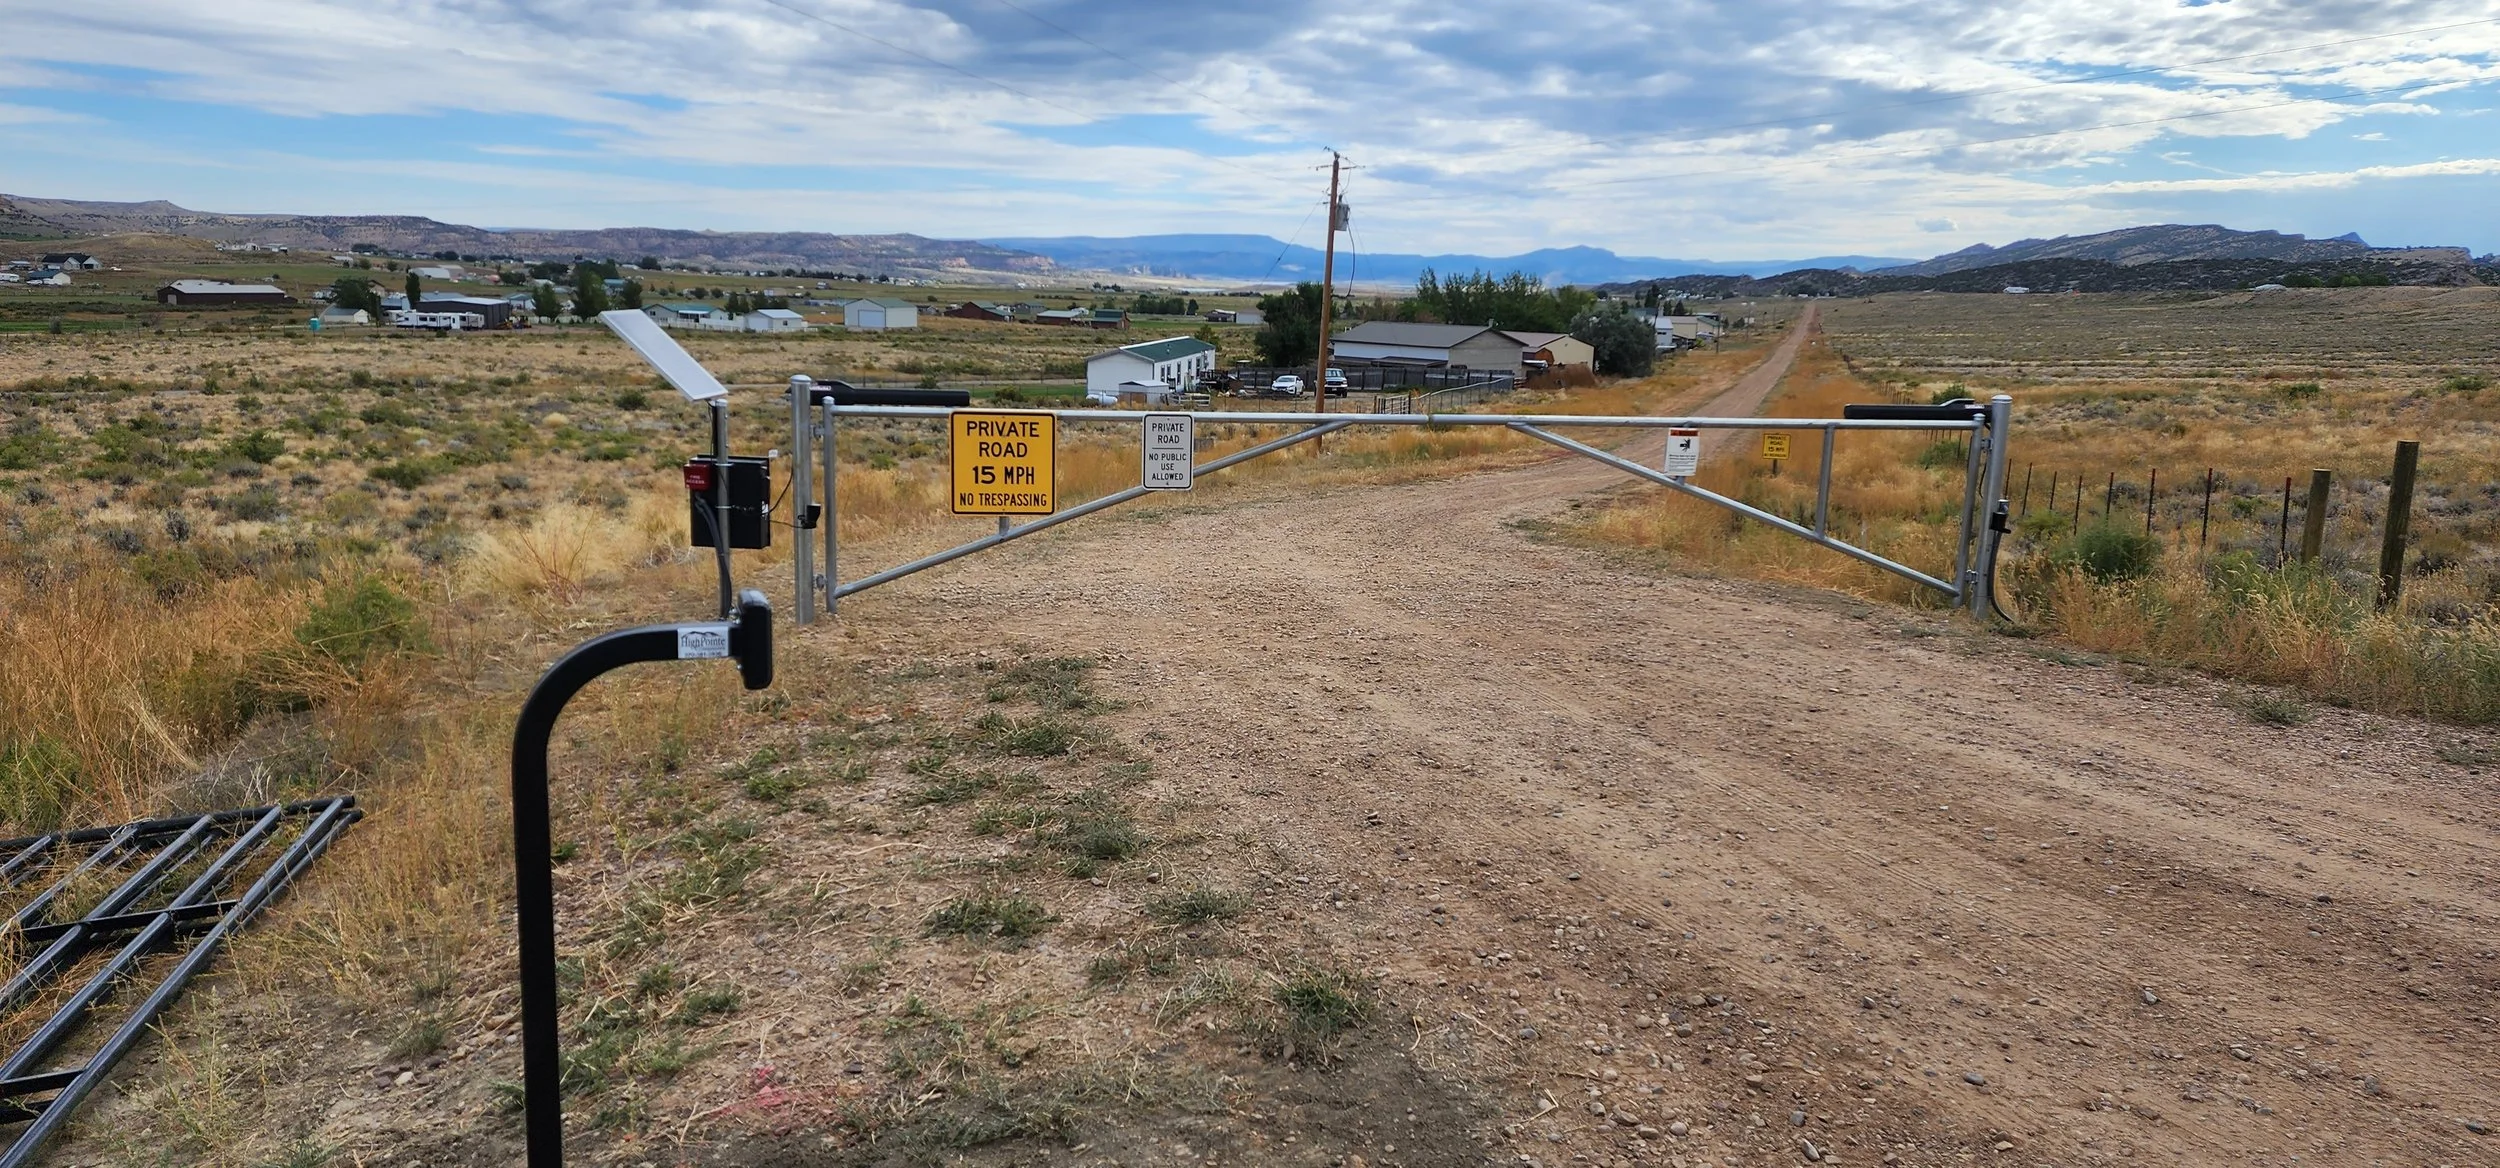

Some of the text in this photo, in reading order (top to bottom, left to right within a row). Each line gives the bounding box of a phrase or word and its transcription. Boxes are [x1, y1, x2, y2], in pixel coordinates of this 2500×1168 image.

[966, 421, 1040, 437] PRIVATE
[1151, 423, 1184, 432] PRIVATE
[1157, 435, 1180, 444] ROAD
[979, 442, 1028, 458] ROAD
[1148, 453, 1187, 461] NO PUBLIC
[1160, 463, 1175, 471] USE
[972, 466, 1035, 485] 15 MPH
[960, 493, 1047, 507] NO TRESPASSING
